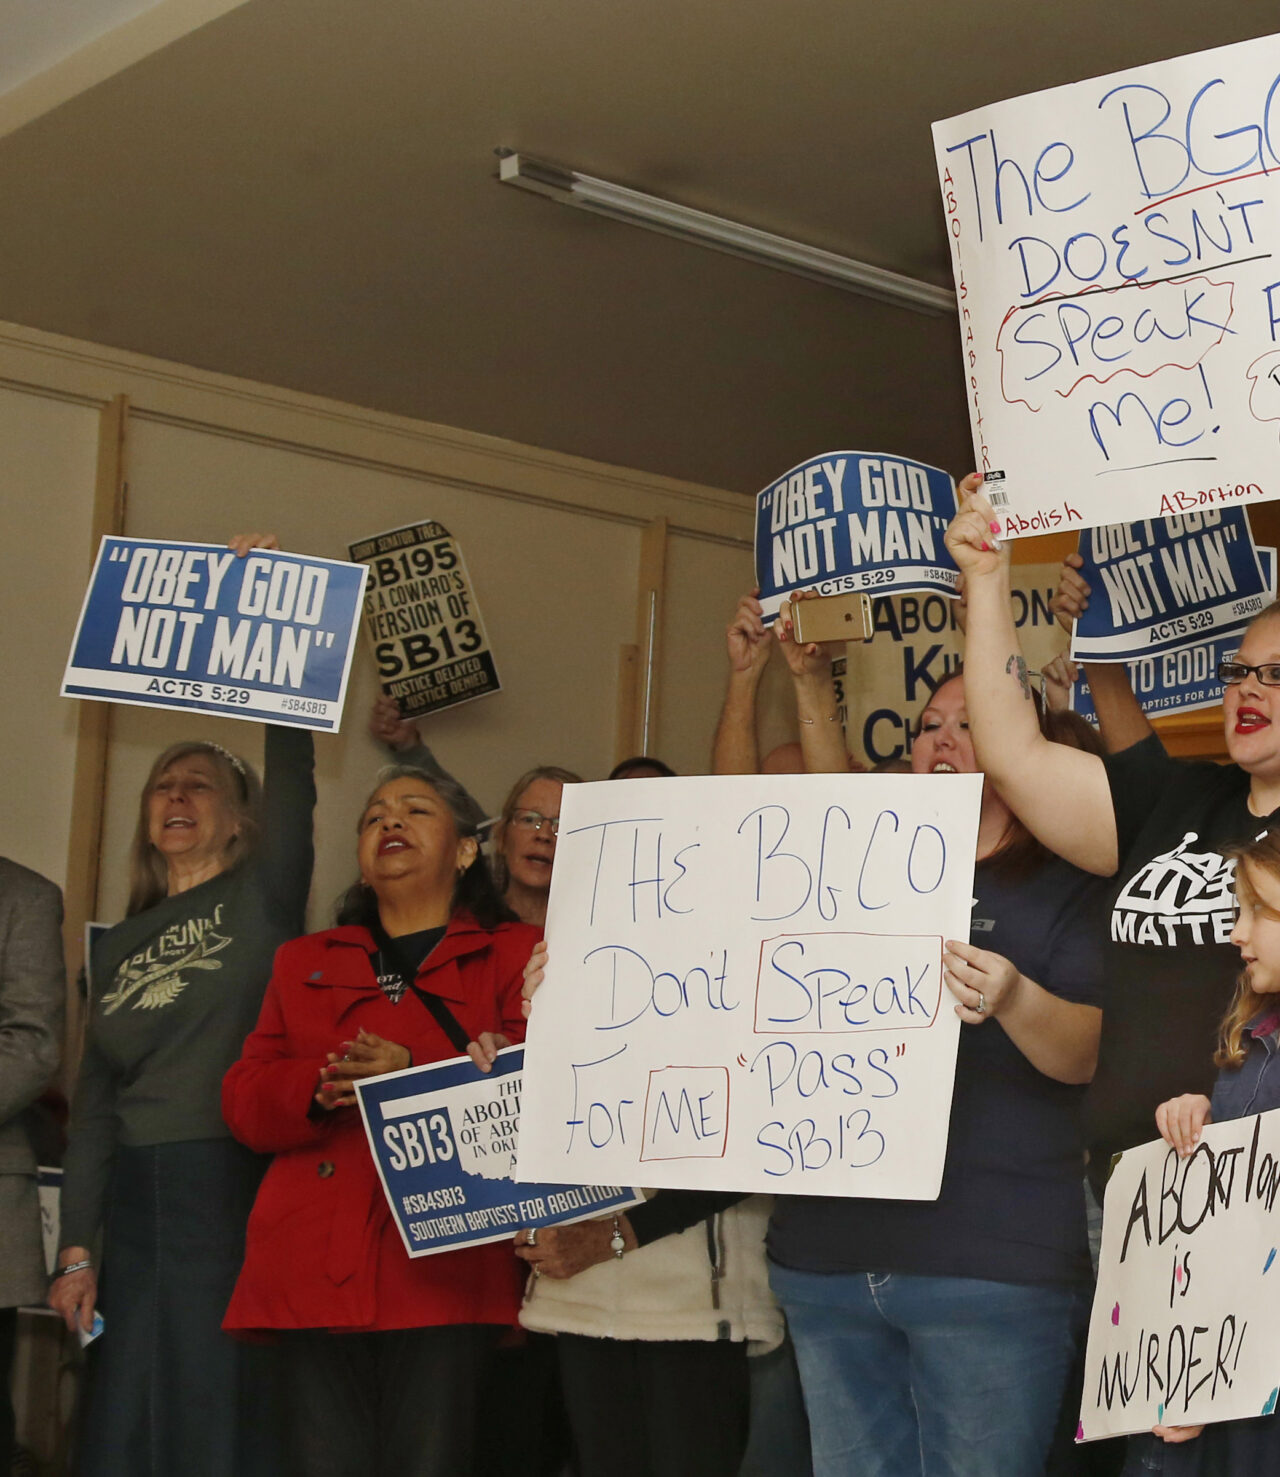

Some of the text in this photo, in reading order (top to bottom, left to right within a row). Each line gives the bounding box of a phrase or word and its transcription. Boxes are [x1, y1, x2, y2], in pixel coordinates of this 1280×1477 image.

[946, 129, 1091, 242] The
[1088, 362, 1221, 460] Me!
[761, 458, 847, 534] "OBEY
[858, 458, 933, 513] GOD
[1005, 502, 1083, 537] Abolish
[772, 517, 837, 588] NOT
[861, 569, 896, 587] 5:29
[1100, 524, 1238, 628] NOT MAN"
[108, 546, 330, 626] "OBEY GOD
[389, 570, 465, 607] COWARD'S
[367, 591, 470, 642] VERSION OF
[1149, 619, 1187, 642] ACTS
[1189, 611, 1214, 629] 5:29
[110, 606, 335, 690] NOT MAN"
[375, 620, 482, 677] SB13
[1127, 645, 1215, 695] TO GOD!
[146, 677, 328, 716] ACTS 5:29 #SB4SB13
[390, 673, 433, 698] JUSTICE
[434, 657, 481, 683] DELAYED
[405, 685, 448, 710] JUSTICE
[450, 671, 488, 695] DENIED
[1185, 690, 1204, 702] FOR
[567, 805, 946, 927] THE BGCO
[583, 945, 740, 1030] Don't
[567, 1043, 634, 1154] For
[652, 1087, 720, 1144] ME
[382, 1114, 454, 1172] SB13
[460, 1126, 481, 1145] OF
[473, 1144, 488, 1158] IN
[757, 1108, 885, 1177] SB13
[402, 1186, 466, 1215] #SB4SB13
[409, 1186, 624, 1242] SOUTHERN BAPTISTS FOR ABOLITION
[1170, 1244, 1191, 1308] is
[1097, 1314, 1248, 1413] MURDER!
